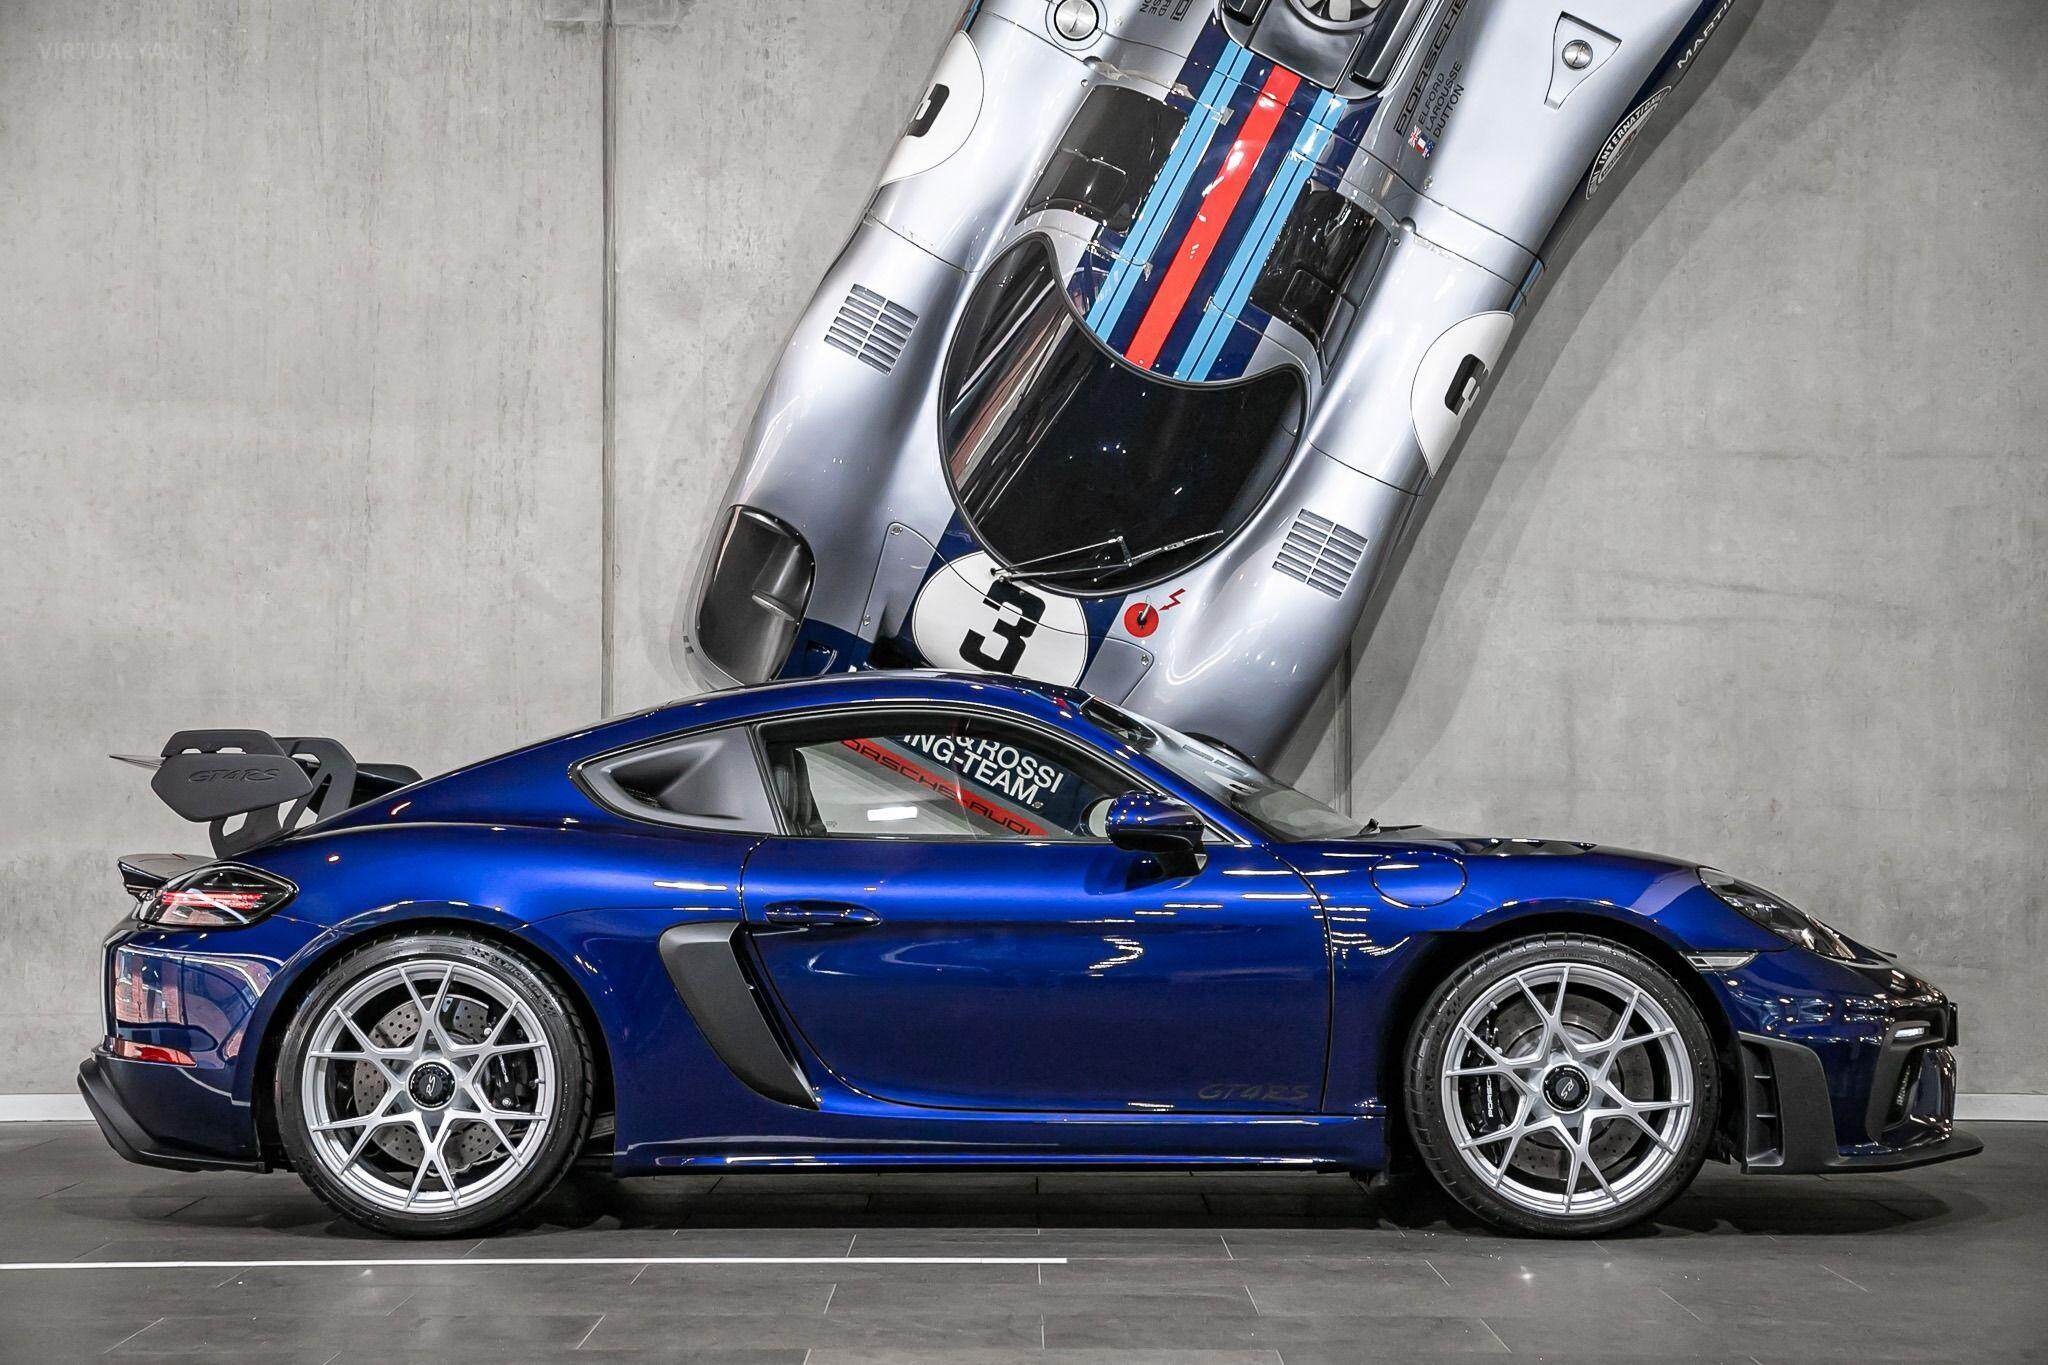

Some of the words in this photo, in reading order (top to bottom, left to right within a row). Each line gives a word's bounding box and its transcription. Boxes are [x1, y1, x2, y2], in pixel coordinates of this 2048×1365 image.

[1677, 0, 1732, 69] MARTI
[1418, 72, 1445, 125] ELFORD
[1426, 61, 1463, 132] LAROUSSE
[1433, 84, 1465, 138] DUTTON
[959, 579, 1046, 674] 3
[977, 740, 1064, 793] ROSSI
